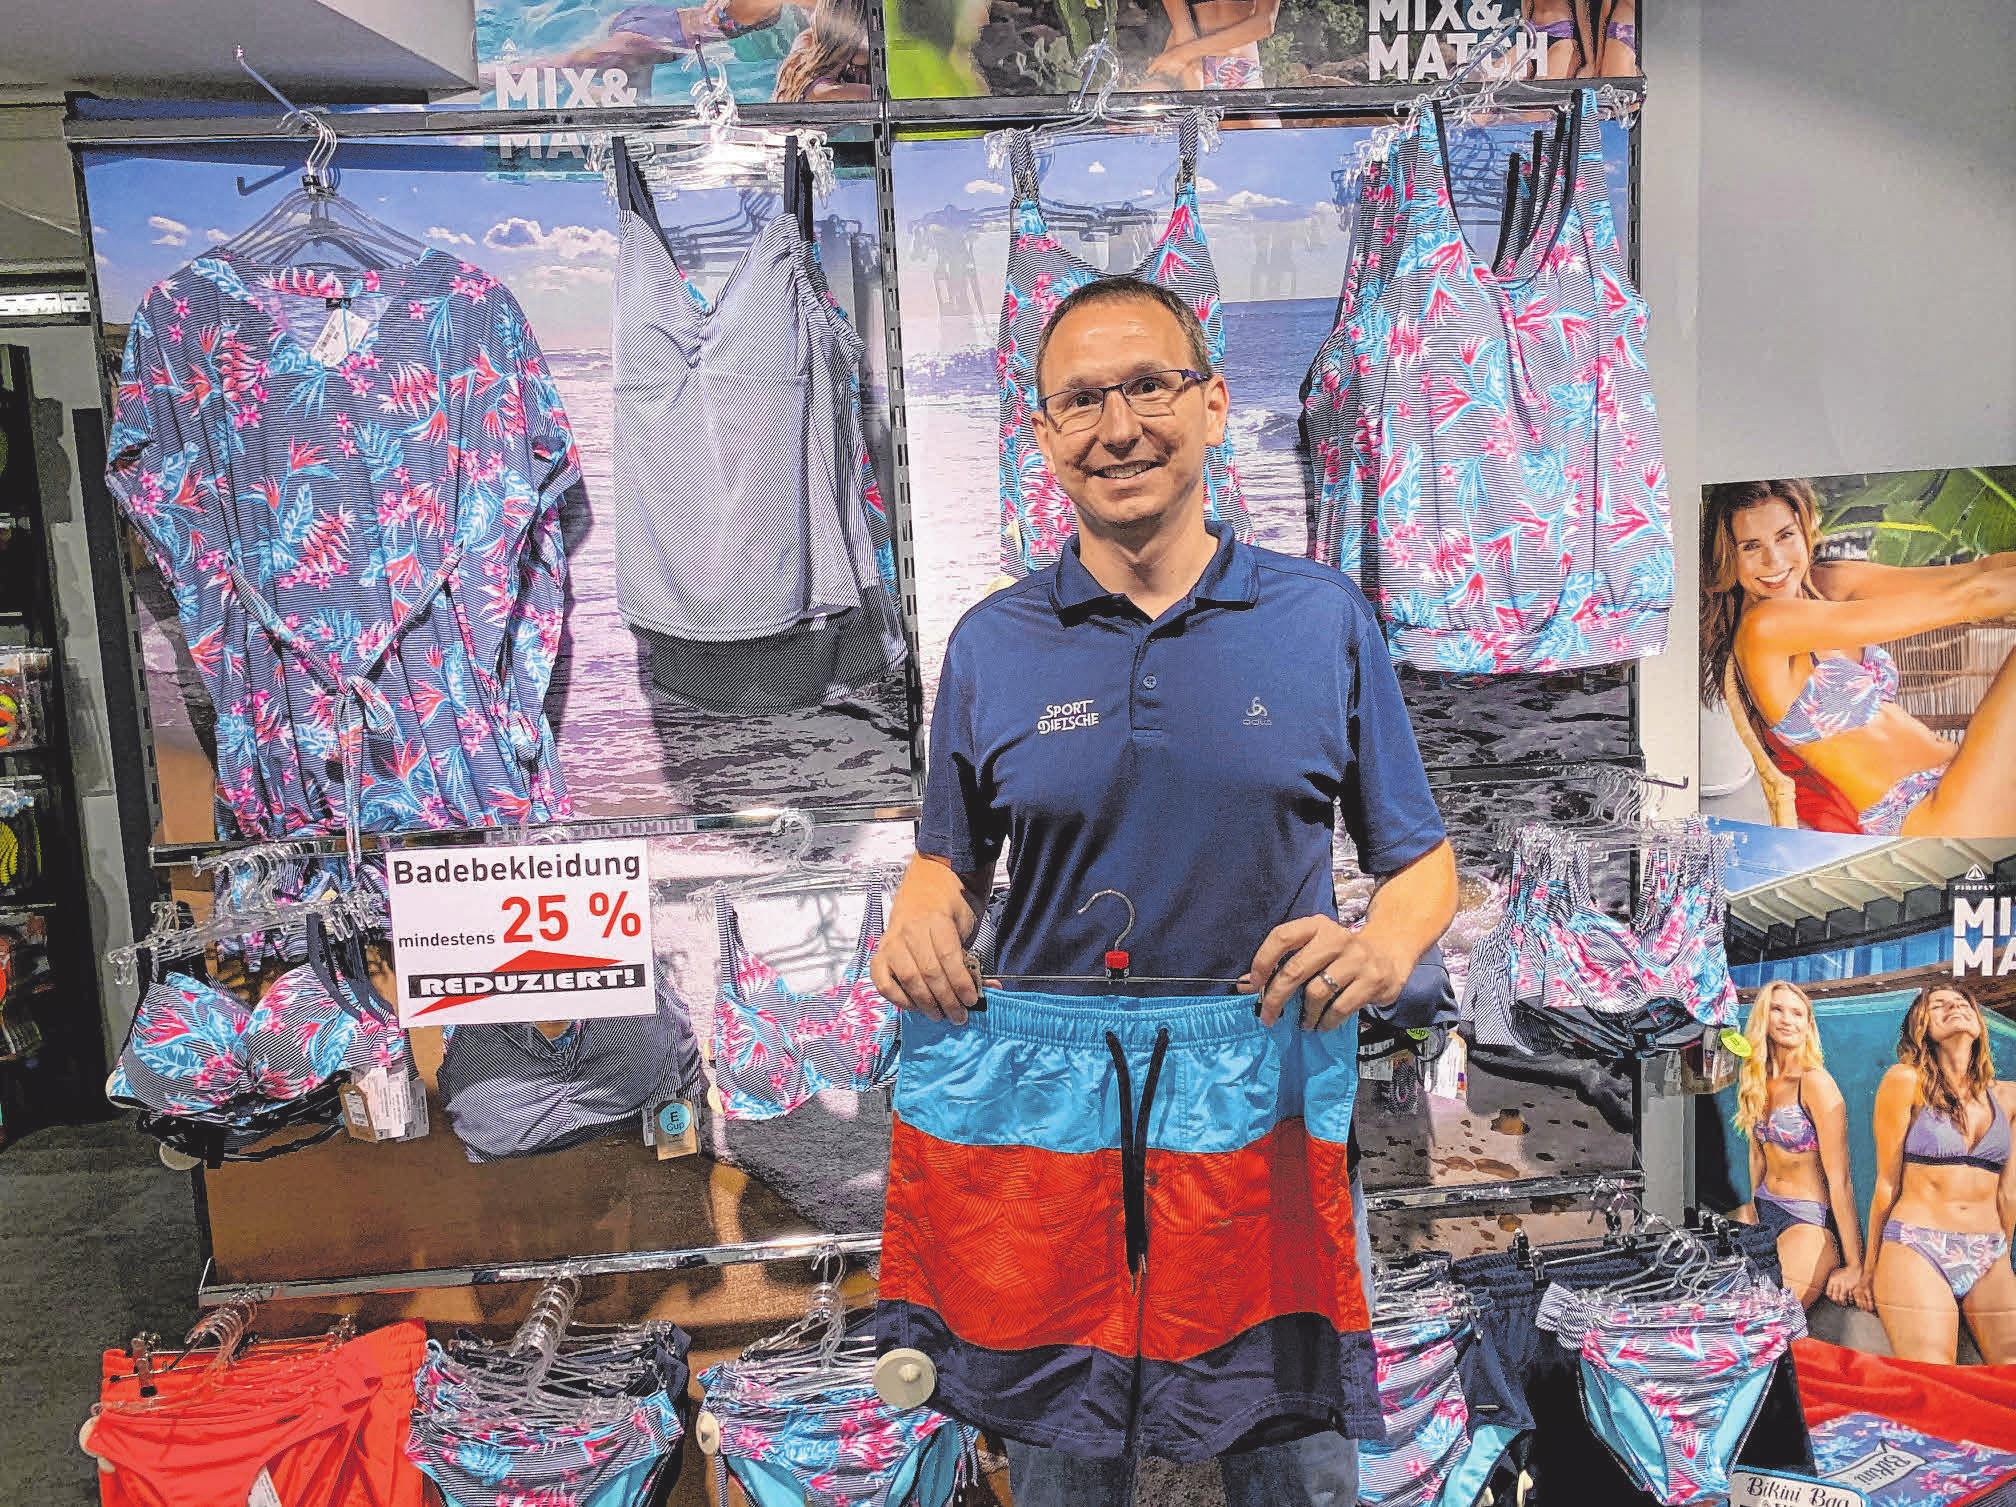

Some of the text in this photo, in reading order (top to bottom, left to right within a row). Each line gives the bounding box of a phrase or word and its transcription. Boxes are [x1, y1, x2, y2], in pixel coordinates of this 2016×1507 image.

[1369, 0, 1502, 31] MIX&
[1368, 32, 1548, 81] MATCH
[496, 67, 637, 109] MIX&
[1037, 713, 1100, 735] DIETSCHE
[1040, 700, 1095, 720] SPORT
[393, 853, 640, 885] Badebekleidung
[398, 891, 641, 948] mindestens 25 %
[1953, 896, 2016, 936] MI
[420, 968, 636, 996] REDUZIERT!
[666, 1122, 685, 1132] Cup
[670, 1111, 680, 1123] E
[1746, 1476, 1801, 1502] Bikini
